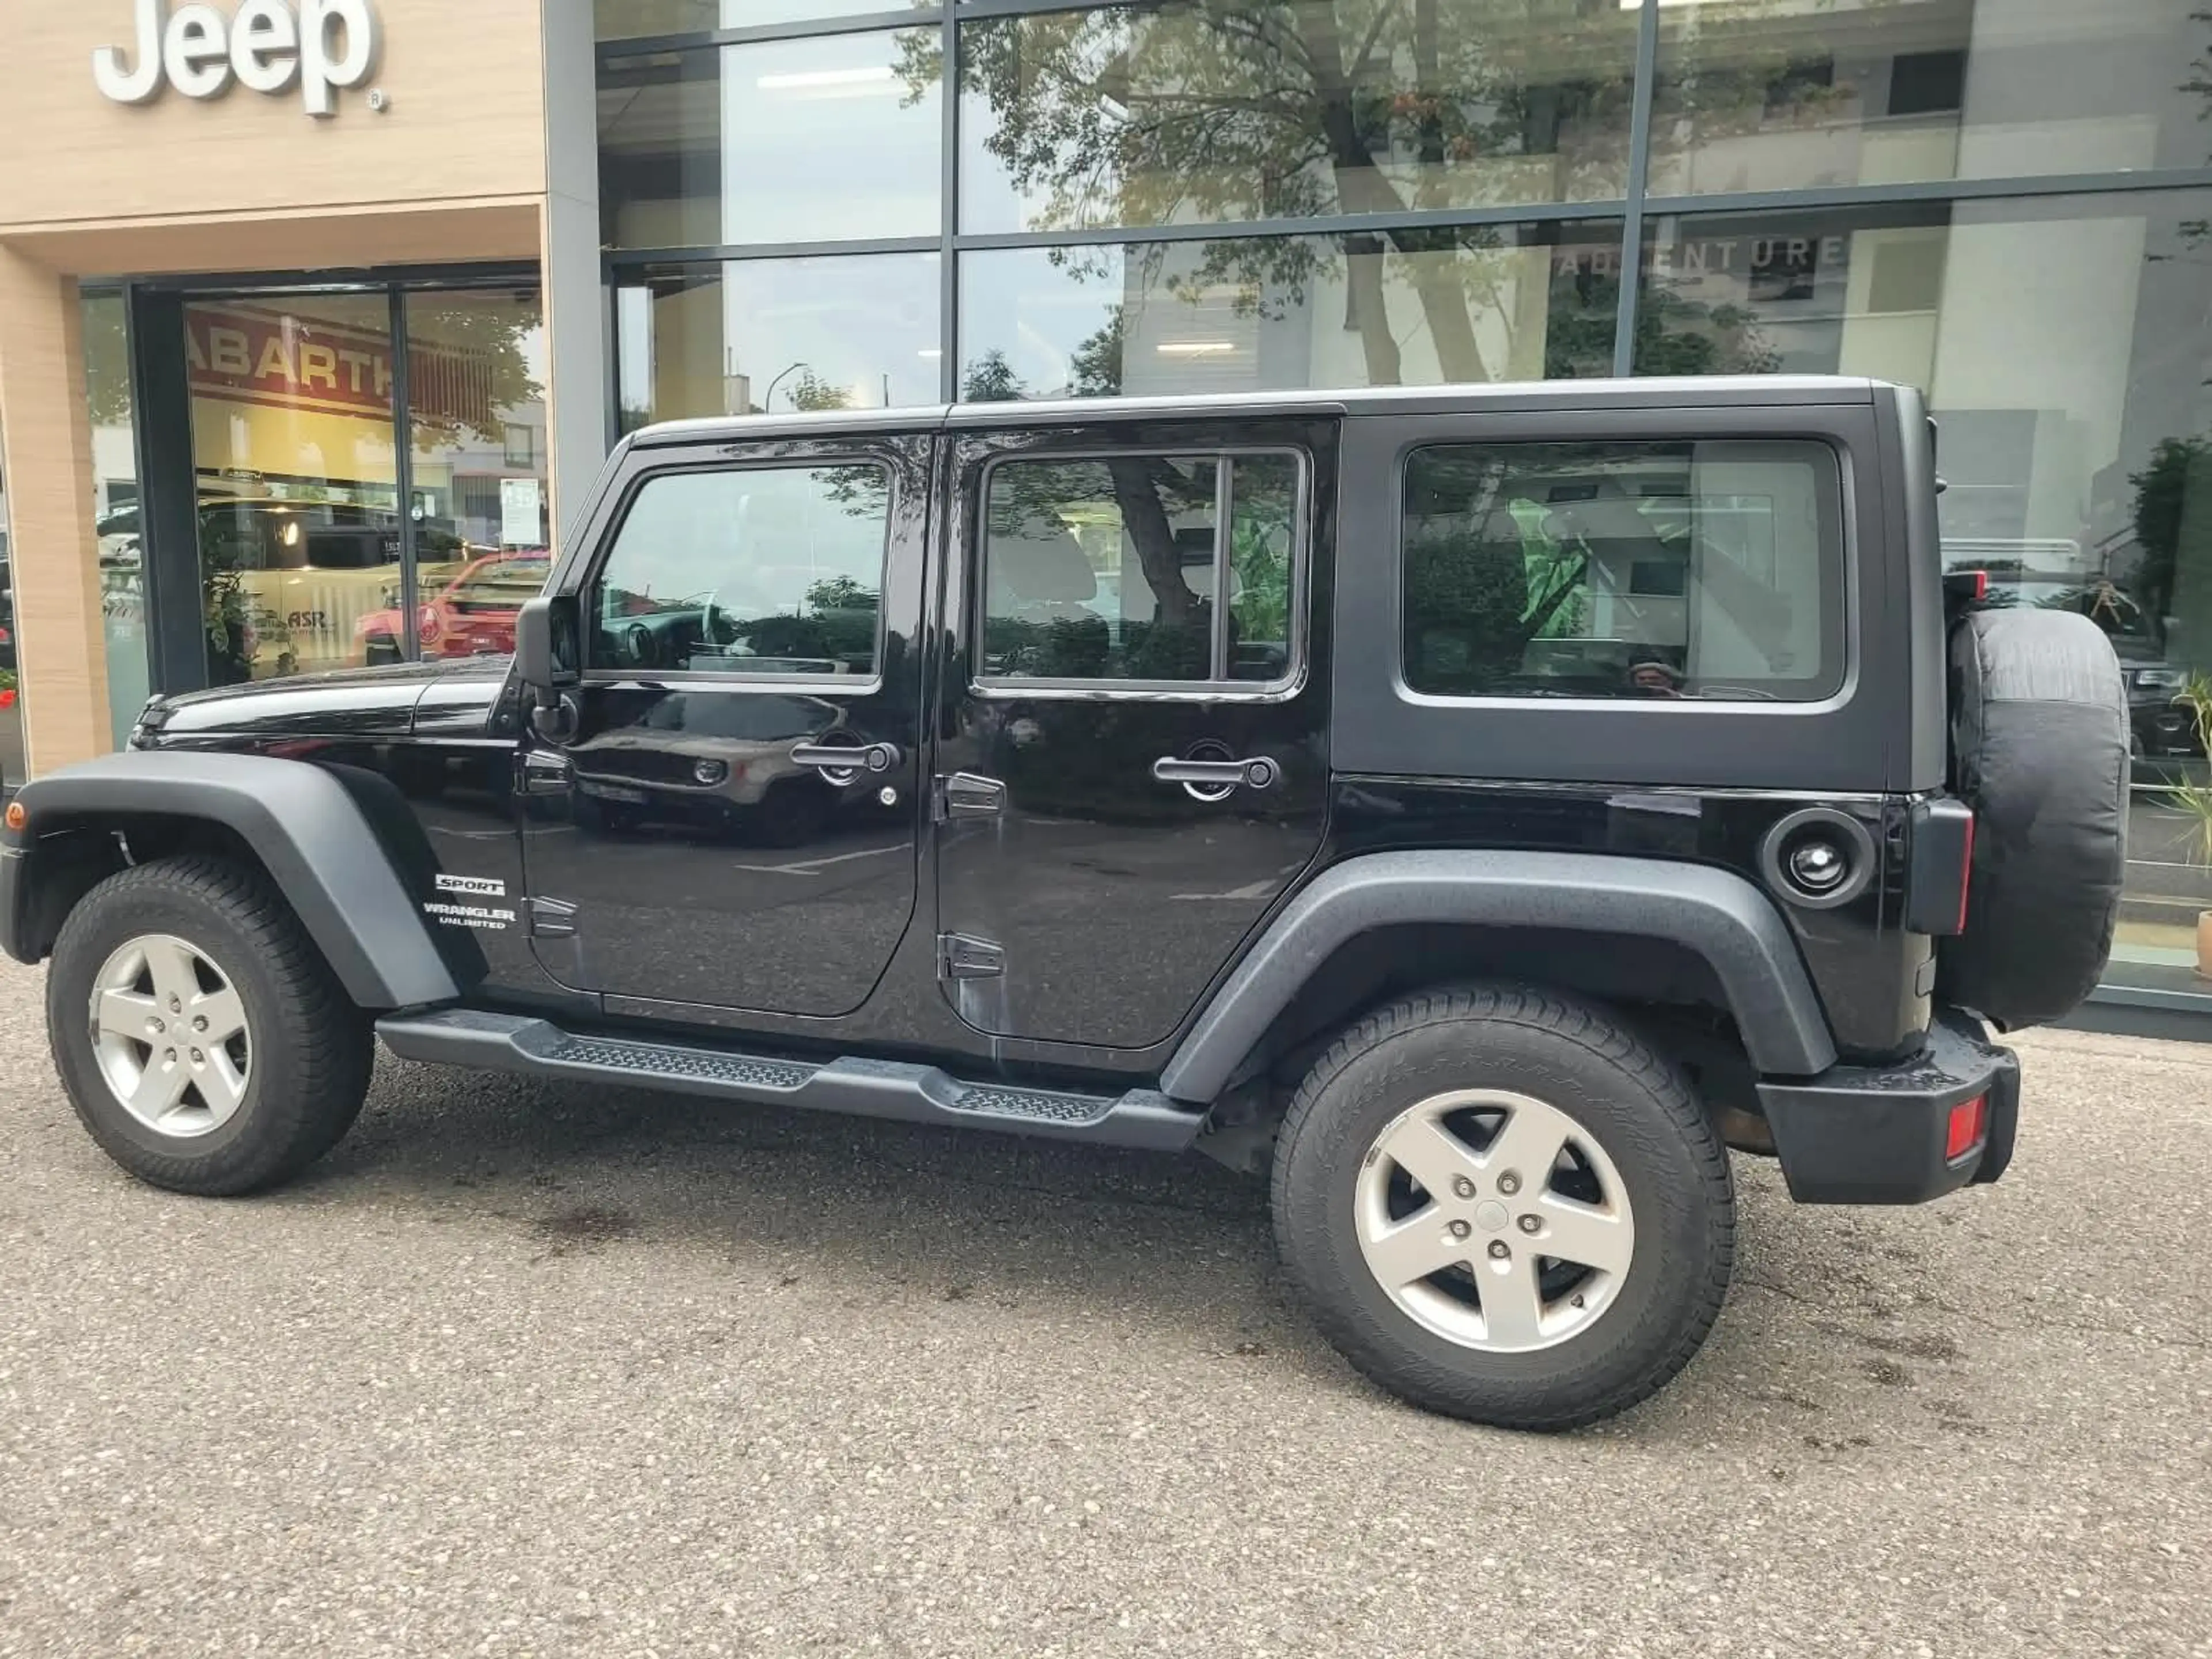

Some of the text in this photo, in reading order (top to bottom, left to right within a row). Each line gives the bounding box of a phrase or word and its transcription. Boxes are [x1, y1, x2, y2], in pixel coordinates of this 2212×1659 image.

[92, 0, 378, 119] Jeep
[1558, 236, 1843, 277] ADENTURE
[440, 878, 505, 892] SPORT
[423, 903, 517, 922] WRANGLER
[439, 916, 506, 930] UNLIMITED
